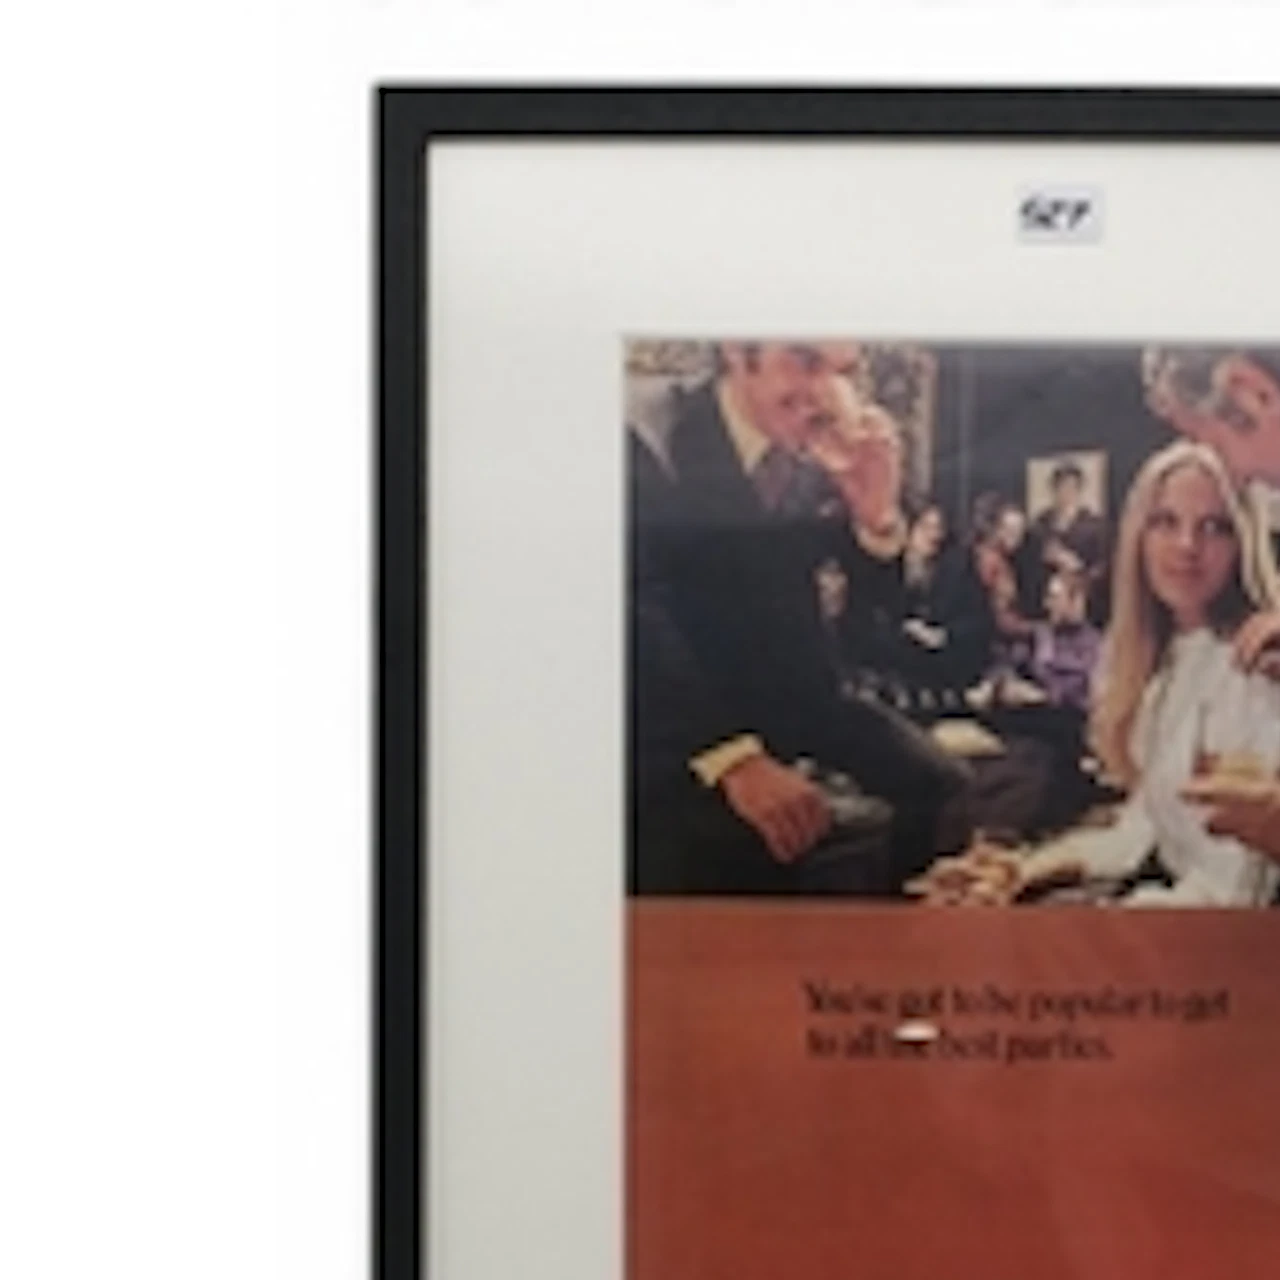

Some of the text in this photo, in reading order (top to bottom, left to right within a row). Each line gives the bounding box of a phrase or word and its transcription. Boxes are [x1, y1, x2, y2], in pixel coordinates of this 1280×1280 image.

[1020, 197, 1092, 231] 527
[805, 983, 1231, 1022] You've got to be popular to get
[806, 1024, 840, 1058] to
[845, 1023, 879, 1058] all
[937, 1026, 1000, 1060] best
[1005, 1026, 1114, 1066] parties.
